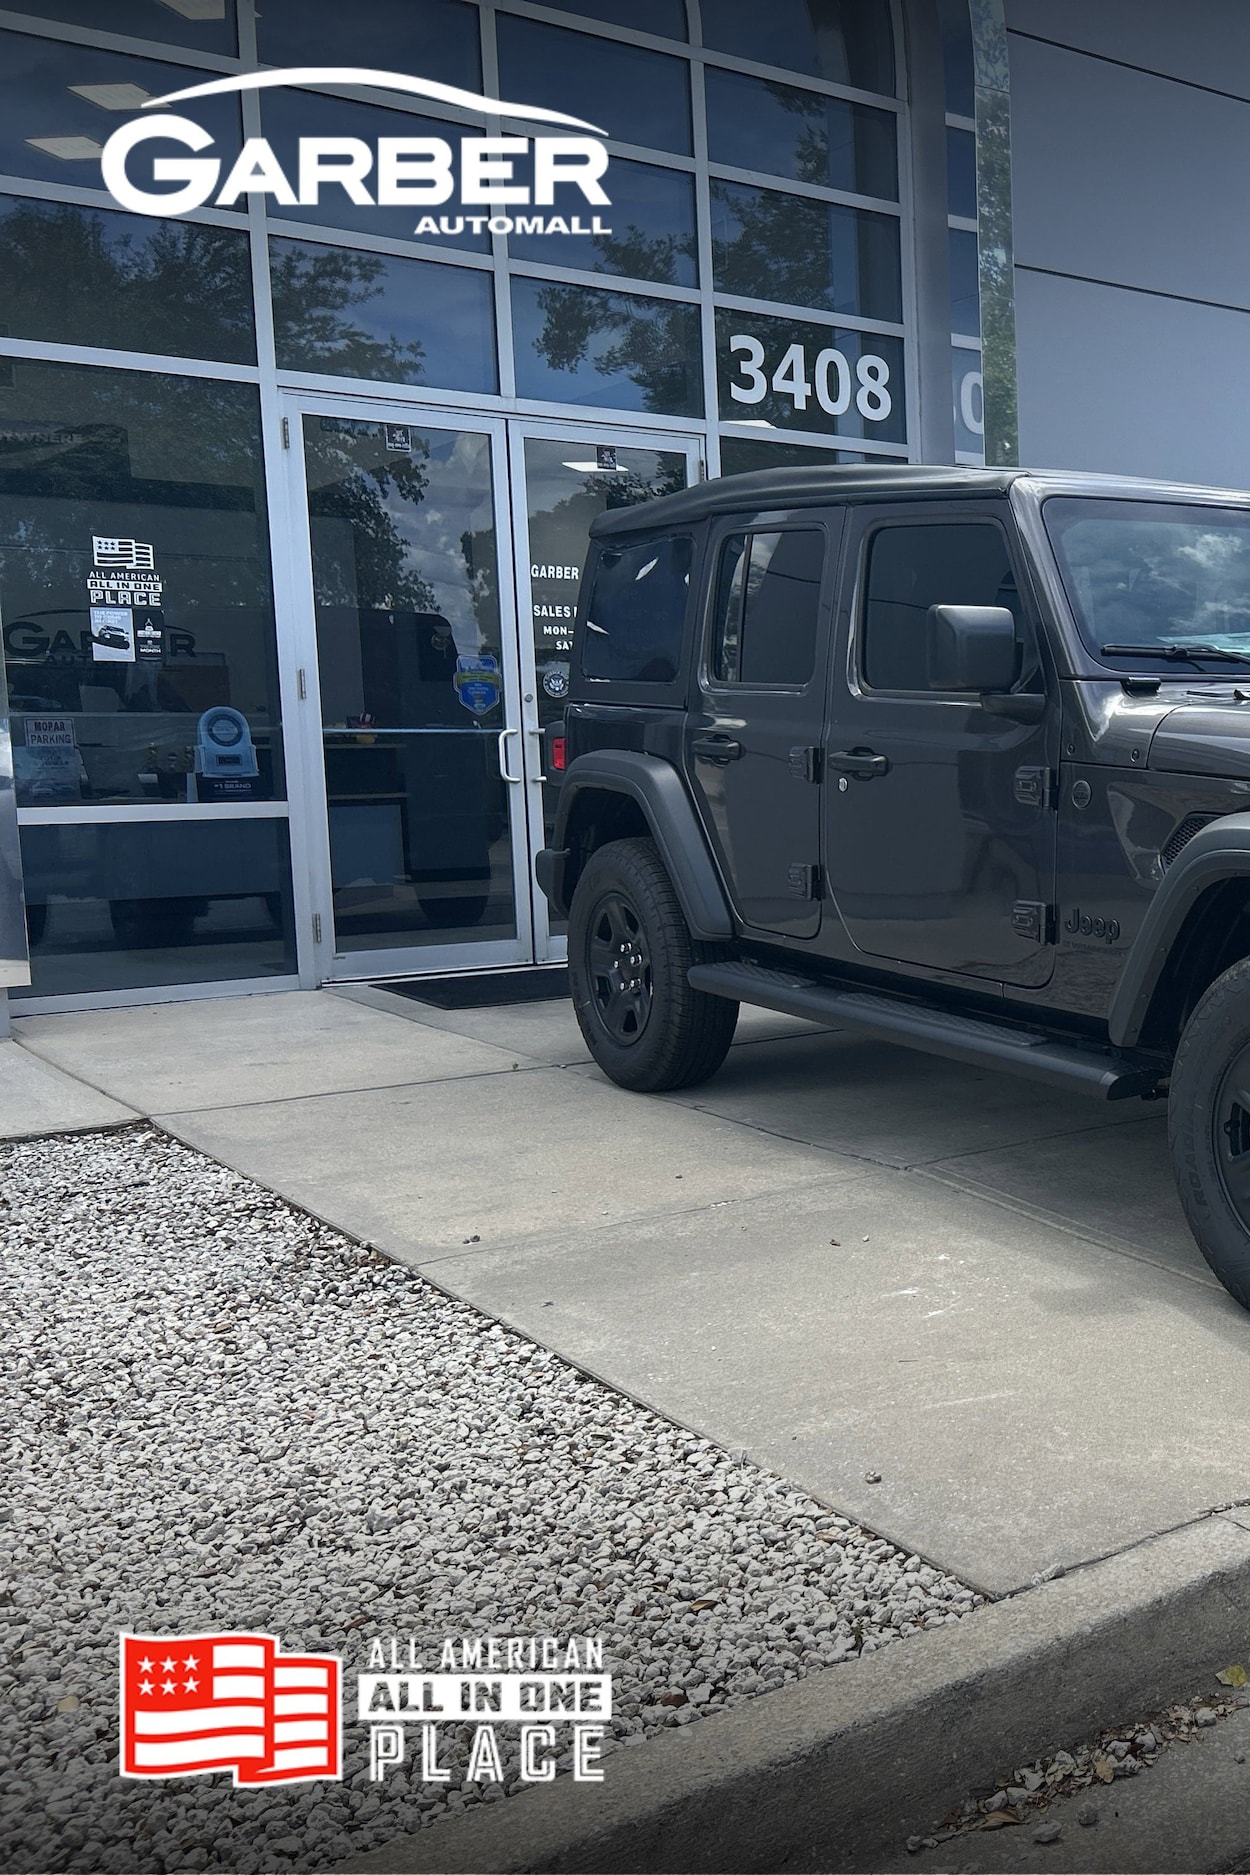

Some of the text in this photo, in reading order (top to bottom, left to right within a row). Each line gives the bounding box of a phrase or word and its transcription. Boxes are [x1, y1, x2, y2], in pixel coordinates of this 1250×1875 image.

[729, 334, 892, 421] 3408
[89, 571, 160, 582] ALL AMERICAN
[531, 564, 579, 580] GARBER
[134, 583, 160, 591] ONE
[90, 590, 161, 606] PLACE
[533, 604, 571, 618] SALES
[4, 621, 196, 657] GAR
[34, 721, 66, 732] MOPAR
[30, 734, 71, 744] PARKING
[1064, 907, 1121, 944] Jeep
